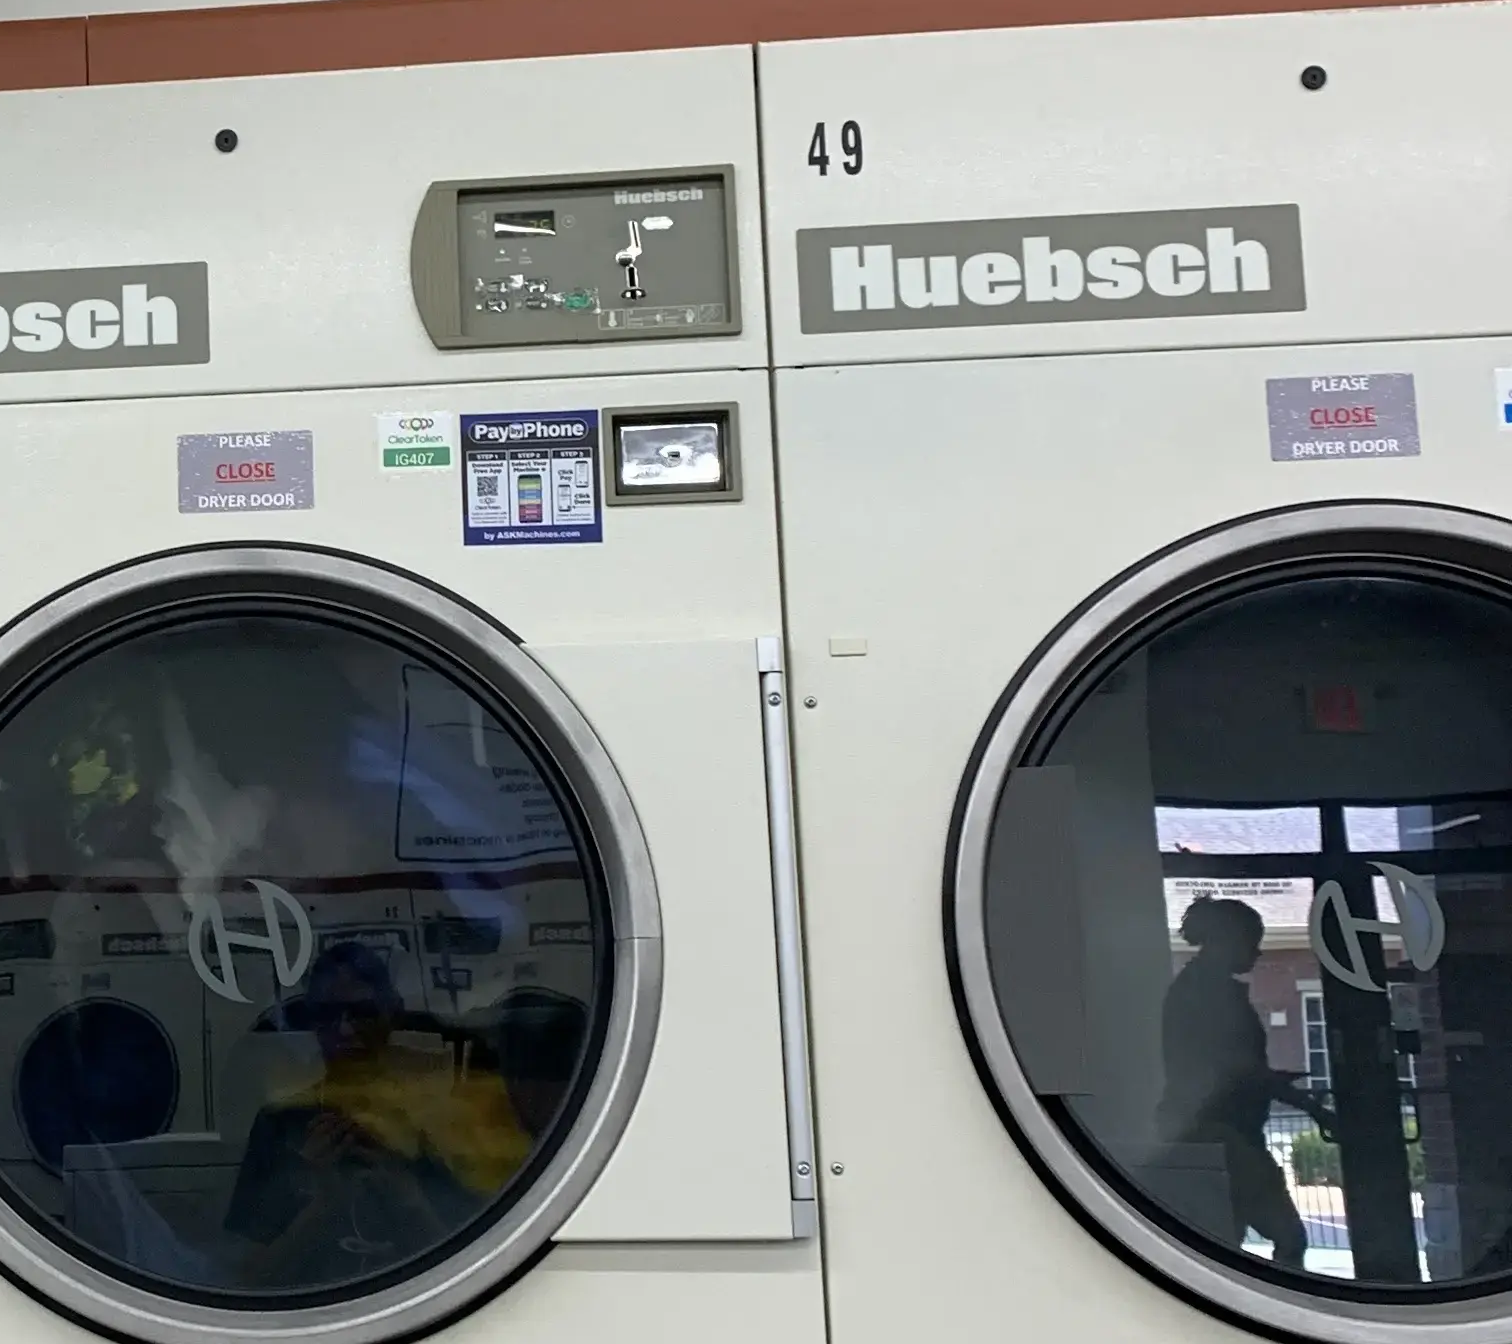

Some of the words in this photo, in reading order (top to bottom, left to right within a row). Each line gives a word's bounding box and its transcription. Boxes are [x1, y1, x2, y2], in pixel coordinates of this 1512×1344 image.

[808, 120, 864, 175] 49
[614, 188, 703, 205] Huebsch
[830, 227, 1271, 312] Huebsch
[1311, 377, 1370, 392] PLEASE
[1310, 407, 1377, 426] CLOSE
[523, 422, 584, 438] Phone
[219, 434, 272, 448] PLEASE
[388, 434, 443, 444] ClearToken
[1292, 441, 1345, 457] DRYER
[1350, 439, 1400, 453] DOOR
[395, 452, 434, 466] IG407
[216, 462, 276, 480] CLOSE
[198, 494, 246, 508] DRYER
[250, 493, 295, 507] DOOR
